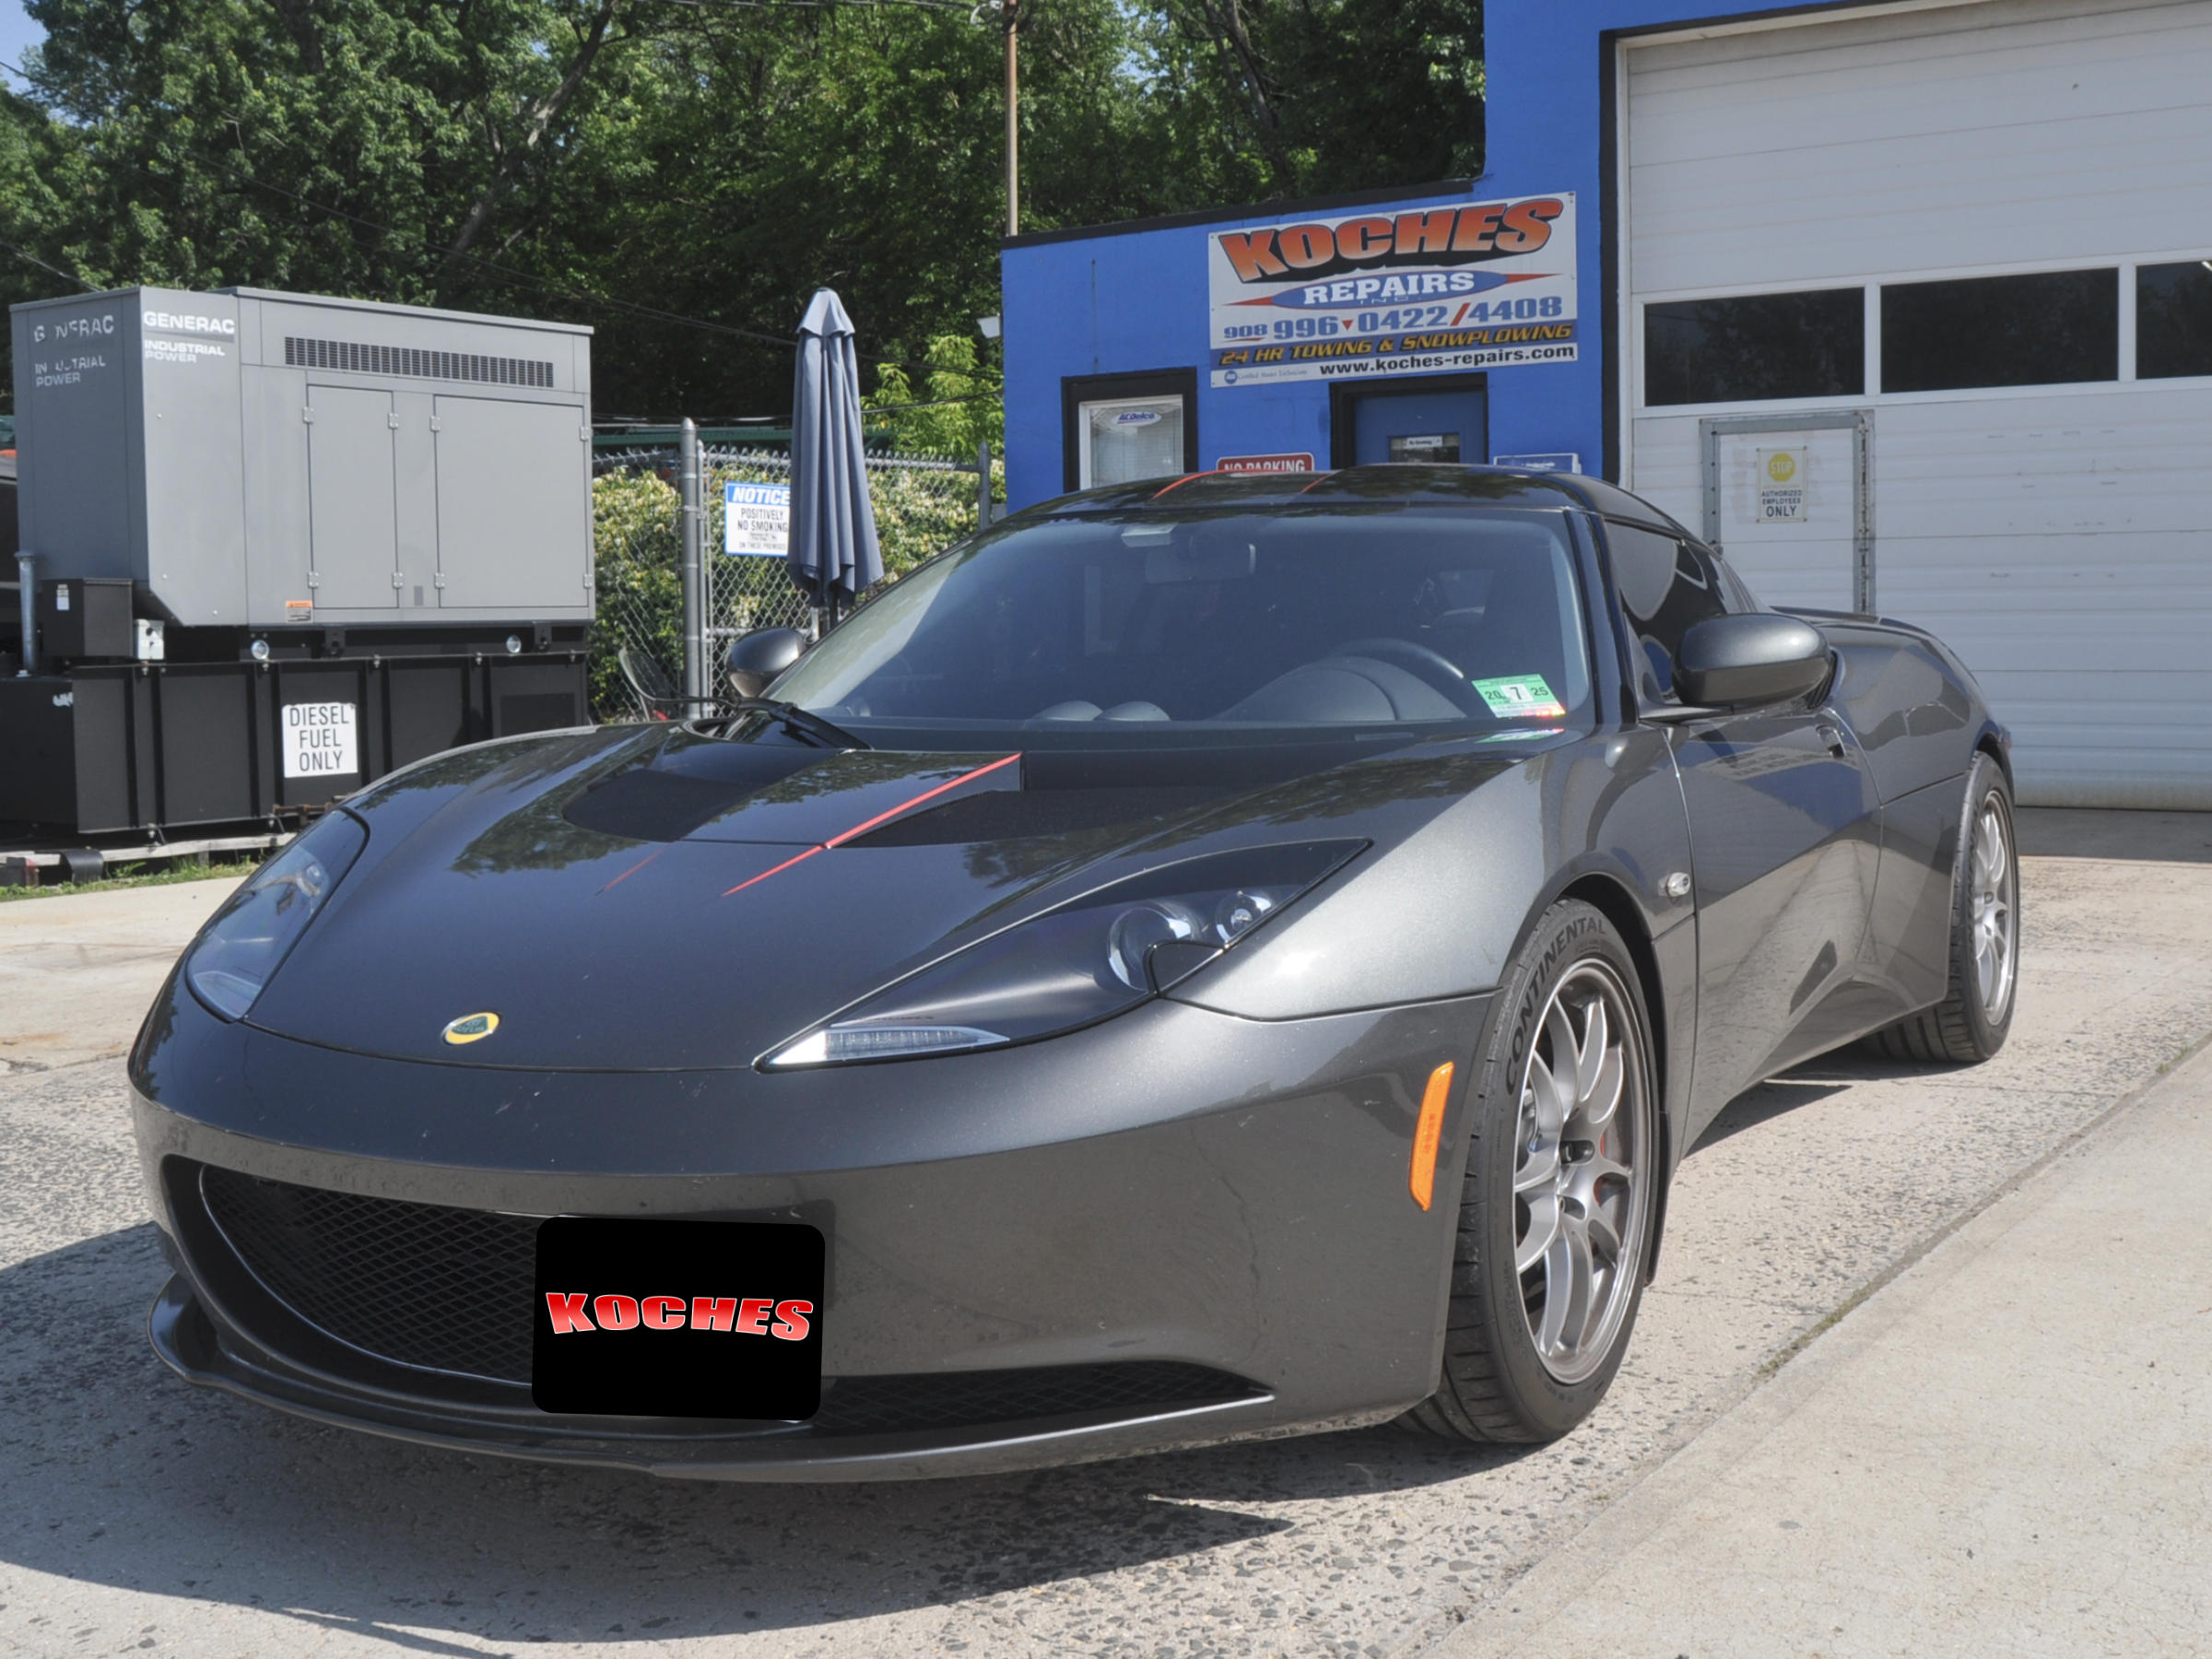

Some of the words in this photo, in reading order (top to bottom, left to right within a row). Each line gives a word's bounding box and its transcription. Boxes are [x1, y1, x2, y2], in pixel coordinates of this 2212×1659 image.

[1218, 197, 1564, 283] KOCHES
[1303, 272, 1475, 305] REPAIRS
[143, 311, 235, 335] GENERAC
[1224, 324, 1268, 339] 908
[1273, 315, 1338, 340] 996
[144, 339, 226, 357] INDUSTRIAL
[1219, 348, 1250, 366] 24
[1253, 346, 1285, 363] HR
[1288, 339, 1372, 360] TOWING
[1377, 337, 1394, 353] &
[1399, 323, 1573, 351] SNOWPLOWING
[145, 350, 197, 363] POWER
[1320, 345, 1574, 376] www.koches-repairs.com
[36, 371, 81, 387] POWER
[1246, 459, 1306, 472] PARKING
[732, 487, 790, 505] NOTICE
[1761, 489, 1803, 498] AUTHORIZED
[1761, 498, 1801, 506] EMPLOYEES
[740, 508, 783, 521] POSITIVELY
[1766, 505, 1796, 517] ONLY
[737, 520, 748, 531] NO
[751, 521, 789, 533] SMOKING
[1485, 689, 1501, 700] 20
[1510, 686, 1522, 700] 7
[1530, 687, 1548, 696] 25
[289, 705, 349, 726] DIESEL
[300, 728, 342, 749] FUEL
[299, 750, 343, 771] ONLY
[1506, 916, 1606, 1095] CONTINENTAL
